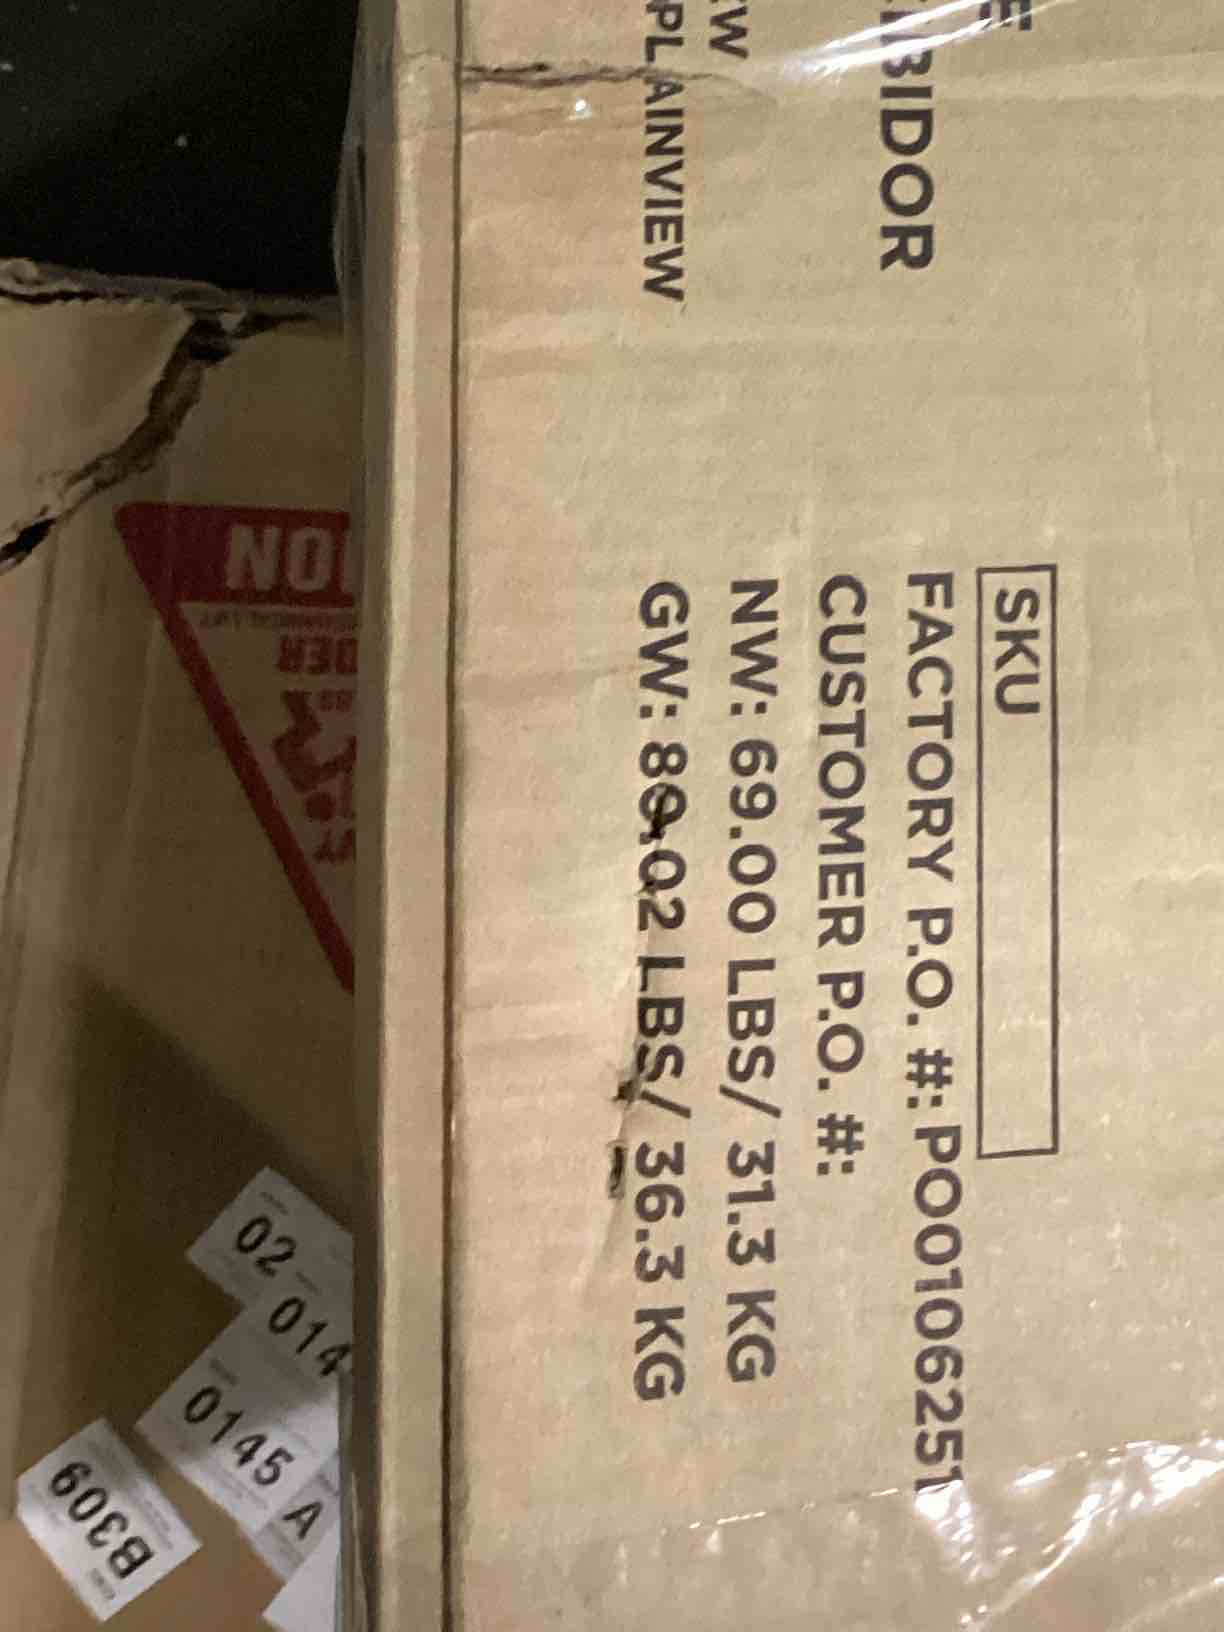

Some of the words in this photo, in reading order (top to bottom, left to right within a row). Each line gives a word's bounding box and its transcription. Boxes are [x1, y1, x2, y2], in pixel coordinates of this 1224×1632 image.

[639, 581, 689, 718] GW:
[731, 580, 778, 715] NW:
[995, 589, 1040, 714] SKU
[818, 575, 867, 947] CUSTOMER
[908, 572, 954, 881] FACTORY
[638, 742, 688, 931] 80.02
[728, 739, 777, 933] 69.00
[907, 908, 953, 1025] P.O.
[818, 971, 864, 1090] P.O.
[906, 1048, 952, 1109] #:
[727, 1142, 775, 1266] 31.3
[818, 1114, 864, 1175] #:
[236, 1215, 297, 1277] 02
[635, 1142, 684, 1282] 36.3
[634, 1307, 685, 1400] KG
[727, 1290, 775, 1382] KG
[183, 1385, 295, 1486] 0145
[49, 1461, 155, 1579] B309
[282, 1499, 323, 1540] A
